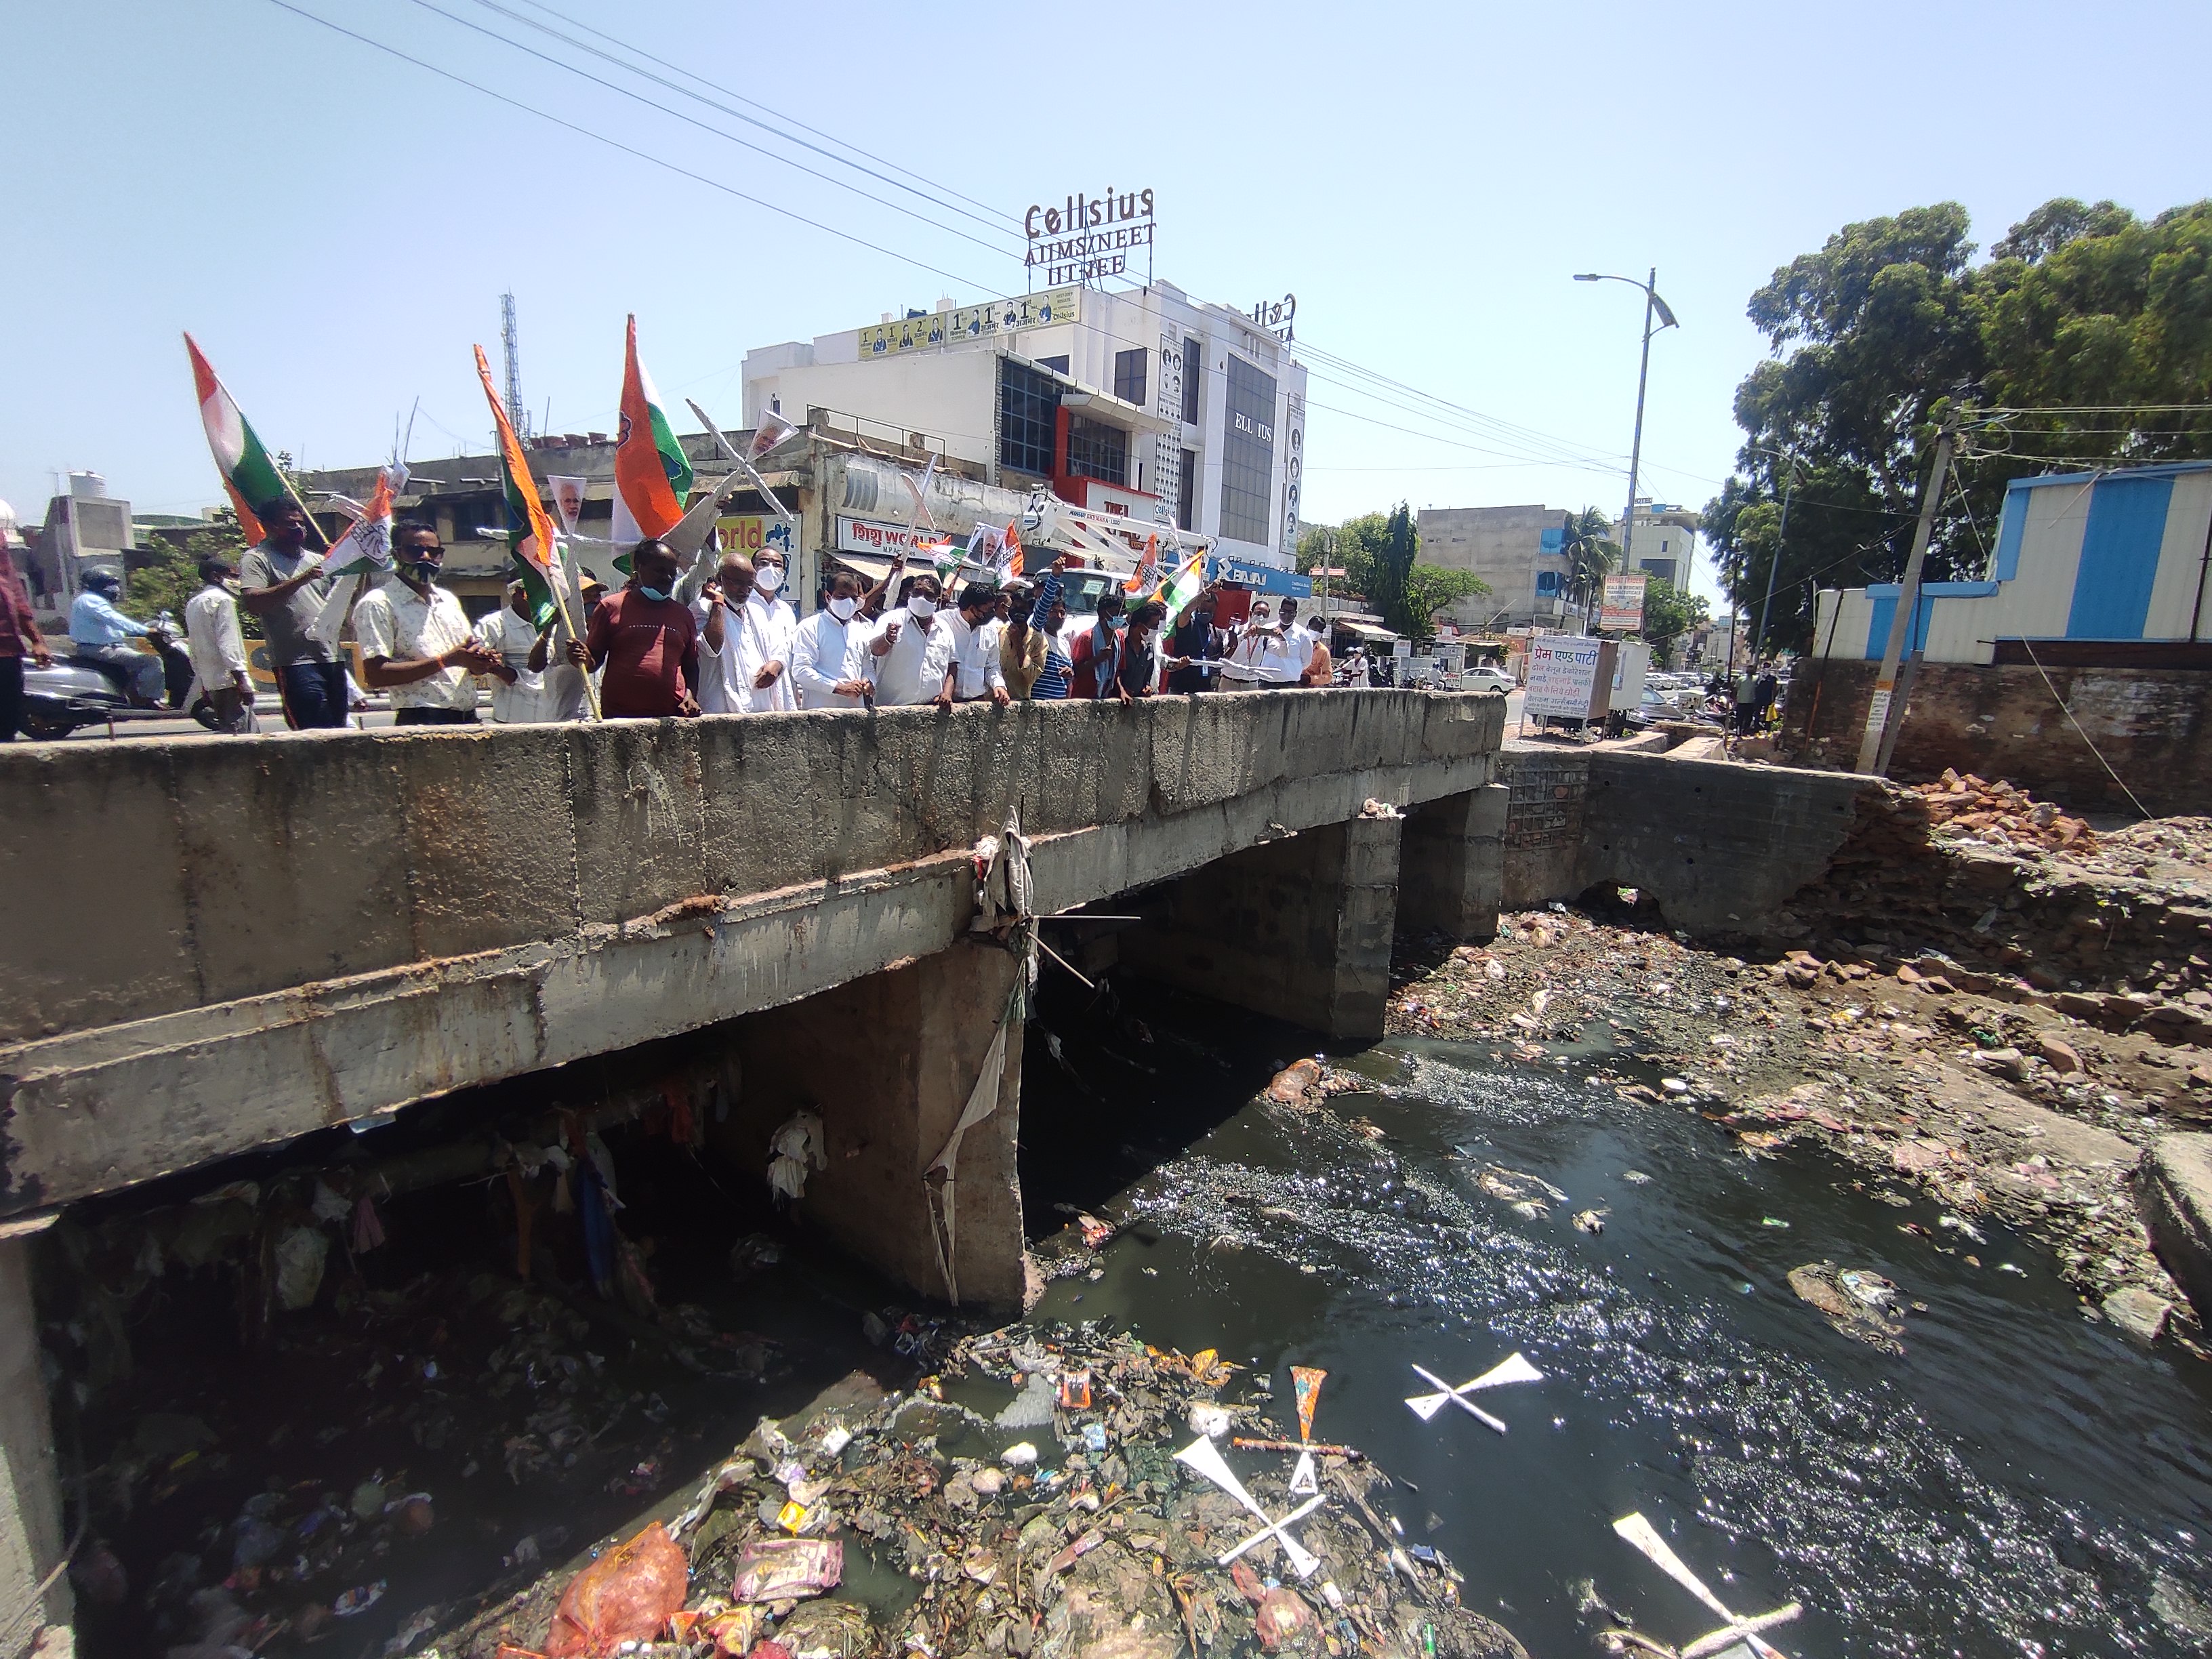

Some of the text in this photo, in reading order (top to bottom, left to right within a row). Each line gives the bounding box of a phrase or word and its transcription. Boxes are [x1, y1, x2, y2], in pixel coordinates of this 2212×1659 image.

[1025, 186, 1153, 239] Cellsius
[1235, 412, 1272, 442] ELL IUS
[1155, 504, 1176, 518] Cellsius
[718, 520, 762, 549] orld
[852, 523, 883, 548] शिशु
[1233, 569, 1267, 586] BAJAJ
[1534, 644, 1553, 661] प्रेम
[1555, 651, 1574, 663] एण्ड
